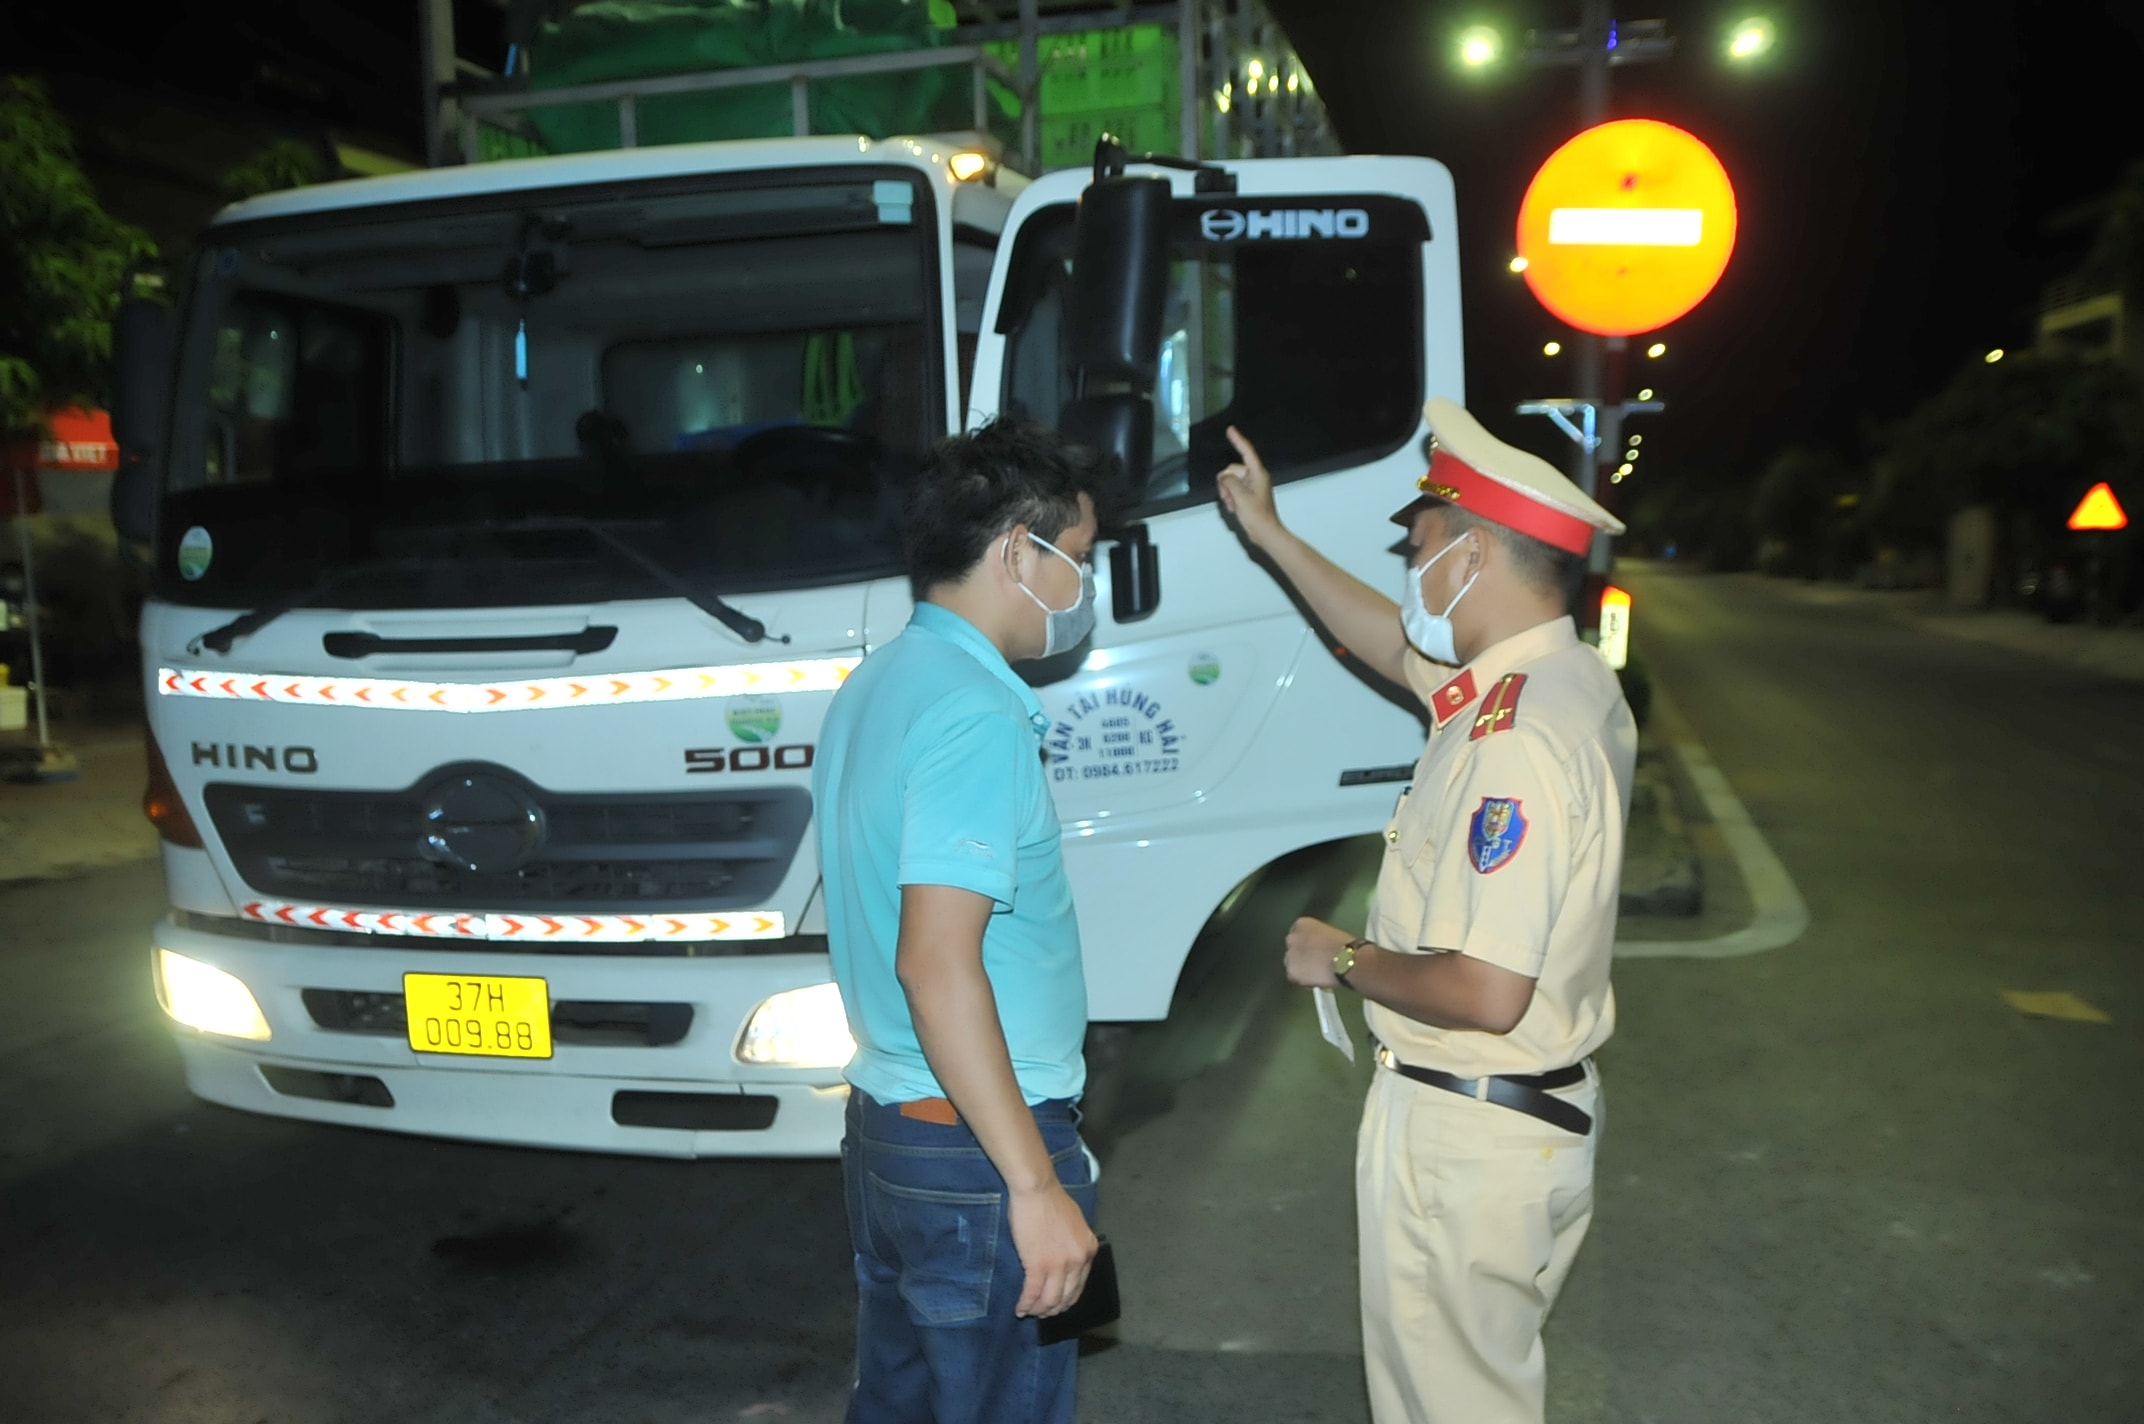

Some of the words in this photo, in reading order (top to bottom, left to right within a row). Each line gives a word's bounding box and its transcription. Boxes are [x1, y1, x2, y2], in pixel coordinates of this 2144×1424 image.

[1247, 208, 1369, 239] HINO
[191, 741, 318, 774] HINO
[685, 744, 814, 773] 500
[446, 981, 504, 1012] 37H
[425, 1017, 533, 1051] 009.88
